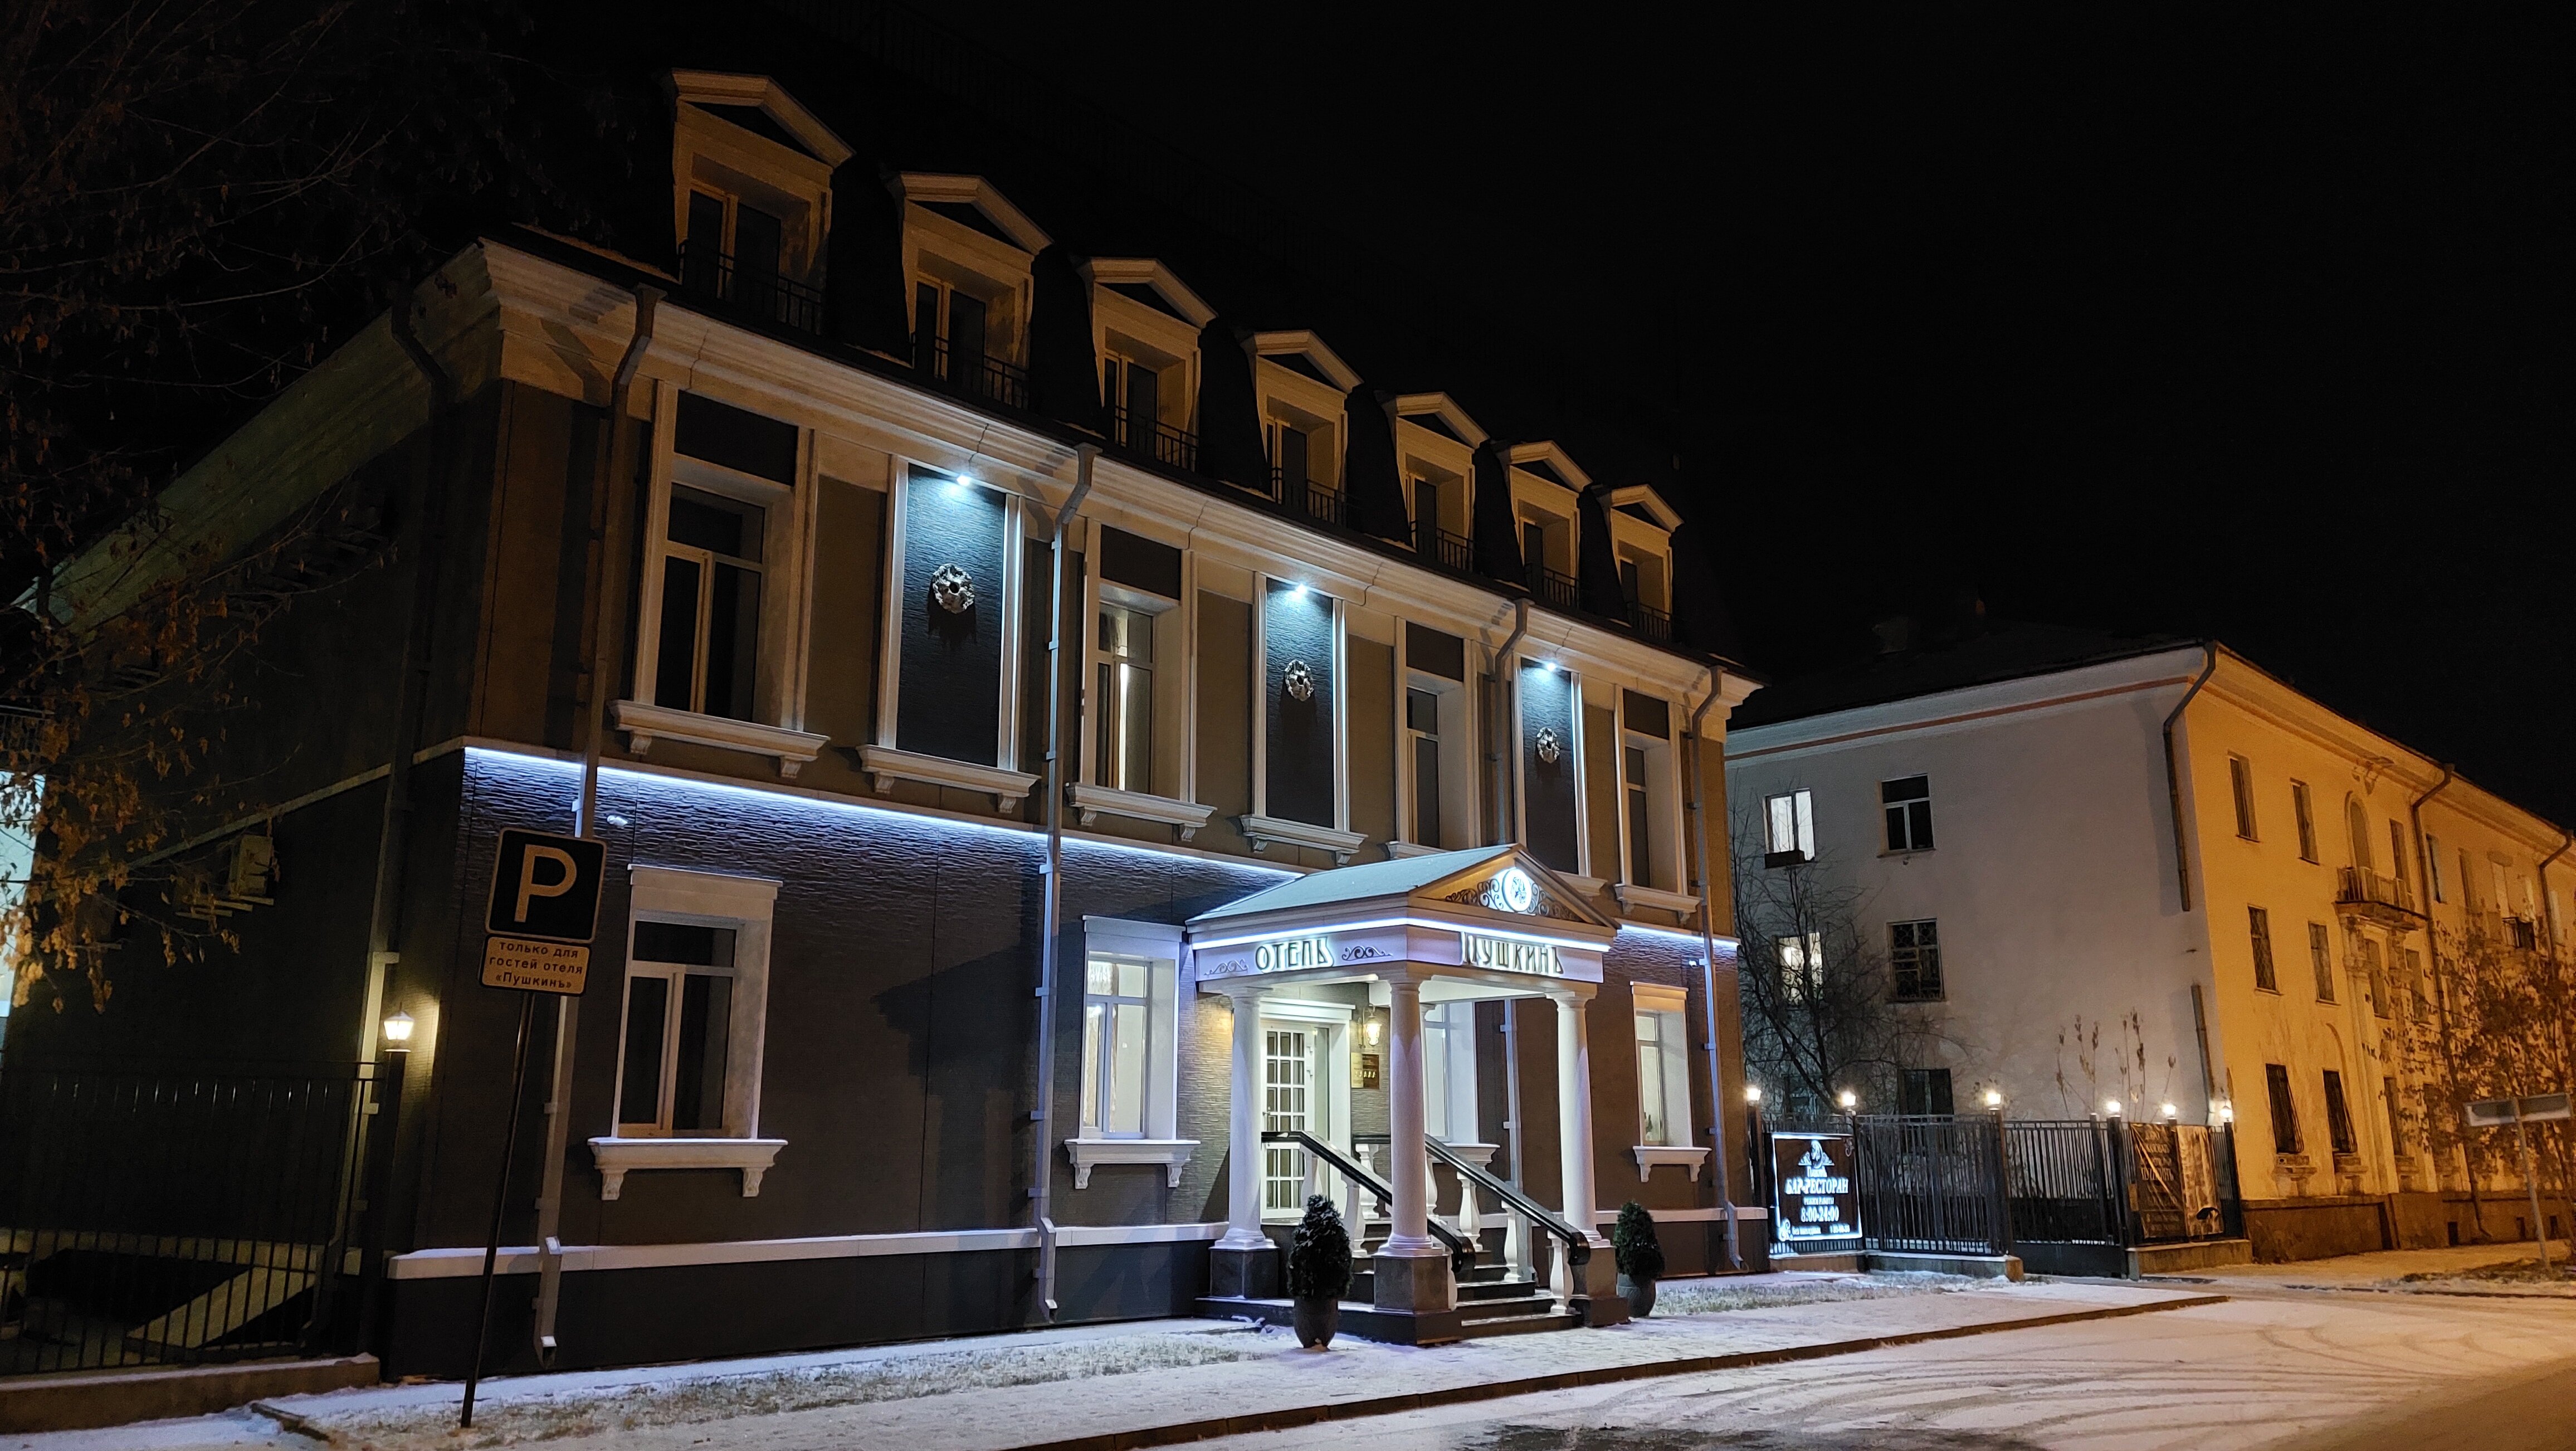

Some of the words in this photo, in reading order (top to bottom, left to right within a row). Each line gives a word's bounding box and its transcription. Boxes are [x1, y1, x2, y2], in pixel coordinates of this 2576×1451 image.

[514, 844, 577, 923] P
[499, 942, 549, 955] только
[553, 947, 579, 959] для
[1255, 937, 1332, 972] ОТЕЛЬ
[1460, 931, 1564, 975] ПУШКИНЪ
[489, 956, 538, 970] гостей
[543, 962, 583, 975] отеля
[495, 972, 572, 989] «Пушкинъ»
[1785, 1176, 1849, 1195] БАР-РЕСТОРАН
